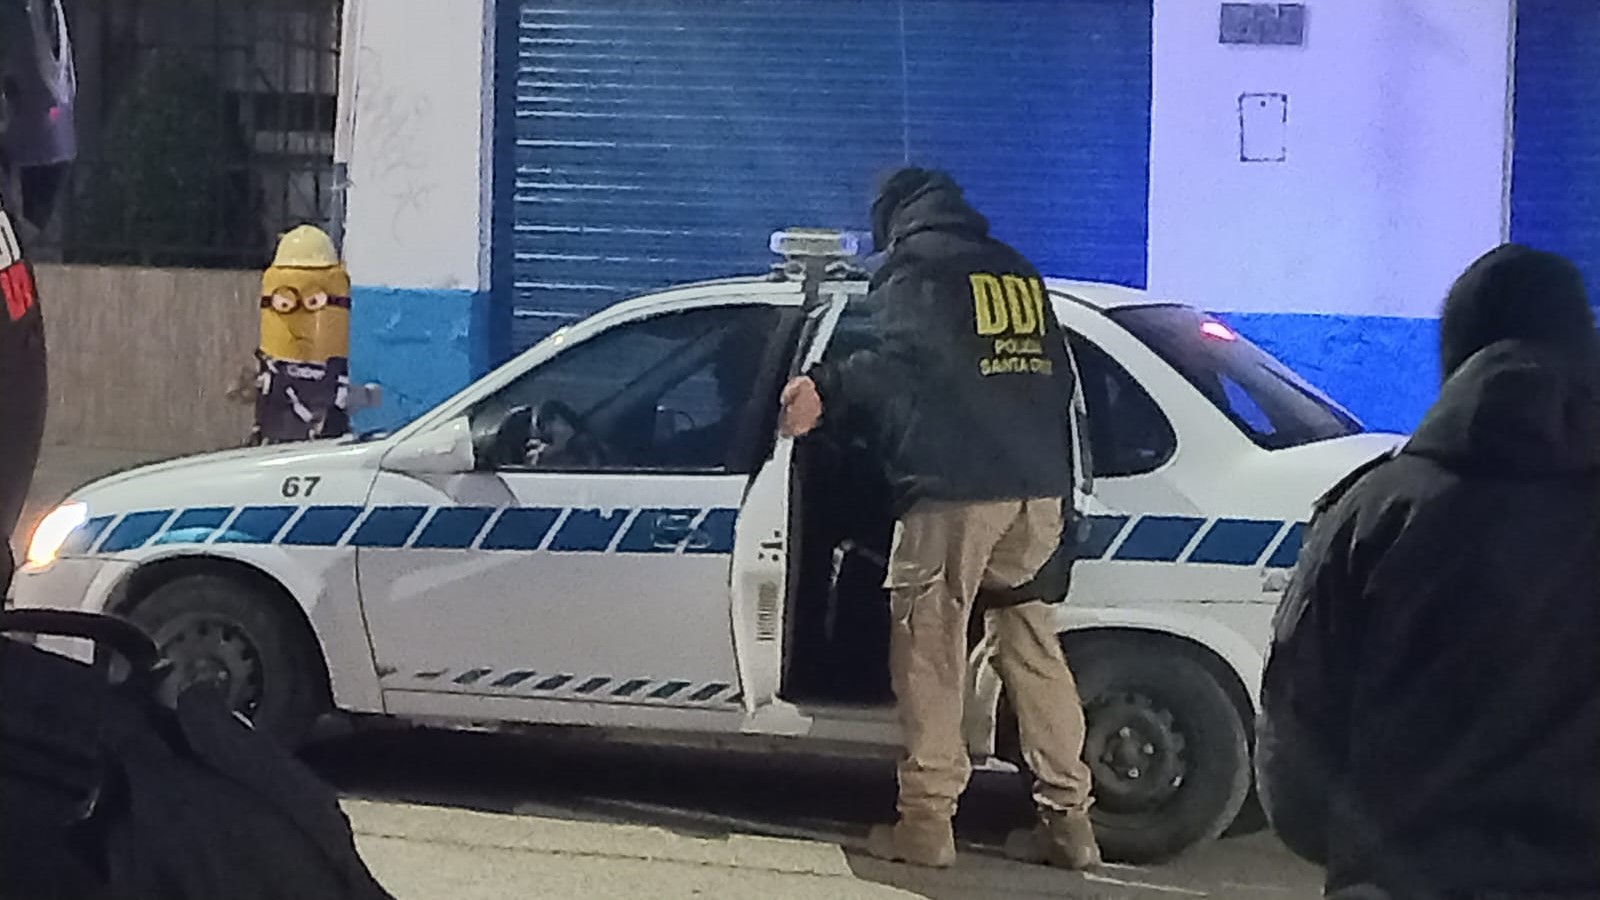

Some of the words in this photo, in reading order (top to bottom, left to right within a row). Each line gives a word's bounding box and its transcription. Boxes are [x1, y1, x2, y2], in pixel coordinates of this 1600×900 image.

[968, 272, 1045, 336] DDI
[994, 339, 1042, 354] POLA
[979, 357, 1028, 376] SANTA
[281, 476, 321, 498] 67
